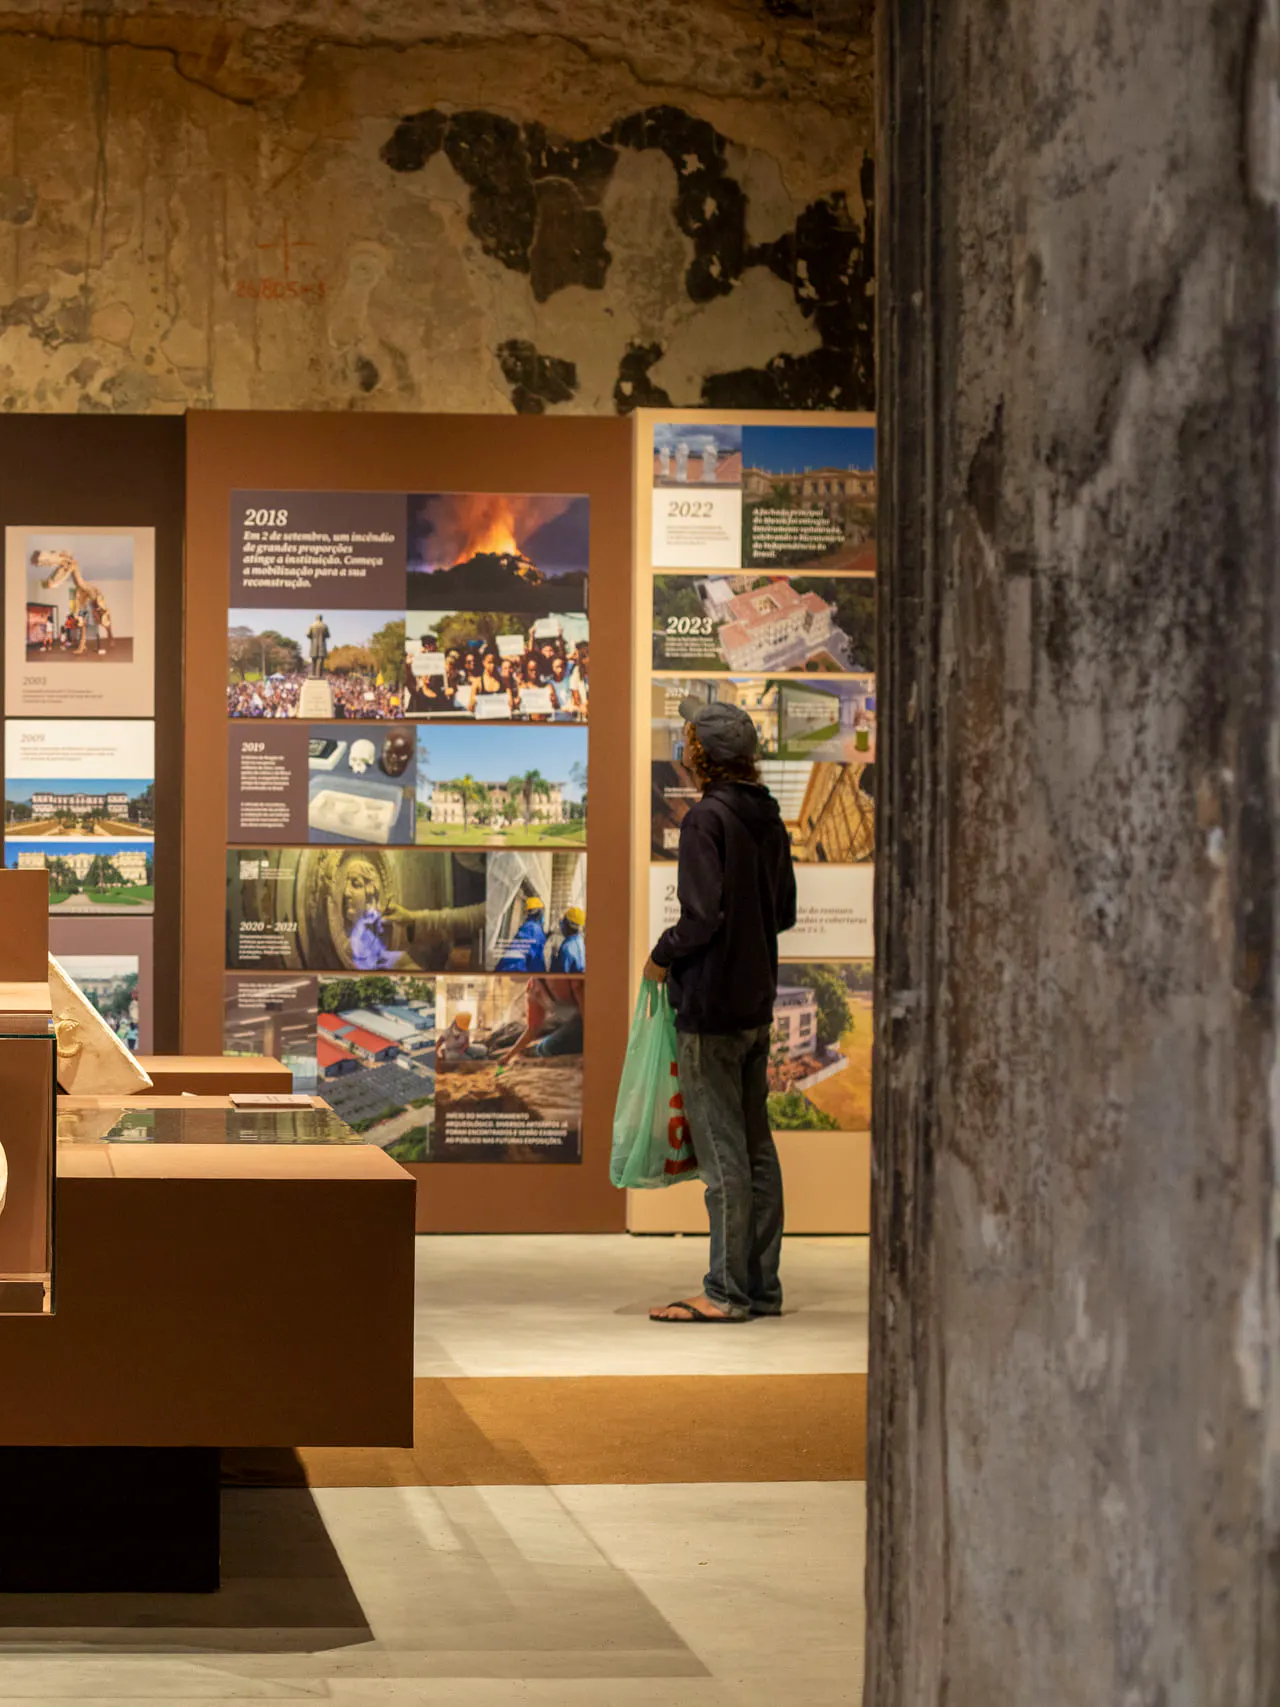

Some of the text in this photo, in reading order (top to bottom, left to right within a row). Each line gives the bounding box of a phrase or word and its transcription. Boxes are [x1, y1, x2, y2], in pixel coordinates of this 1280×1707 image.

[668, 502, 714, 518] 2022
[244, 508, 288, 526] 2018
[243, 531, 396, 543] Em 2 de setembro, um incêndio
[243, 542, 354, 555] de grandes proporções
[243, 554, 275, 566] atinge
[344, 556, 384, 568] Começa
[252, 566, 313, 578] mobilização
[314, 569, 338, 578] para
[243, 578, 312, 590] reconstrução.
[666, 616, 713, 635] 2023
[241, 742, 266, 752] 2019
[240, 921, 264, 932] 2020
[274, 922, 298, 932] 2021
